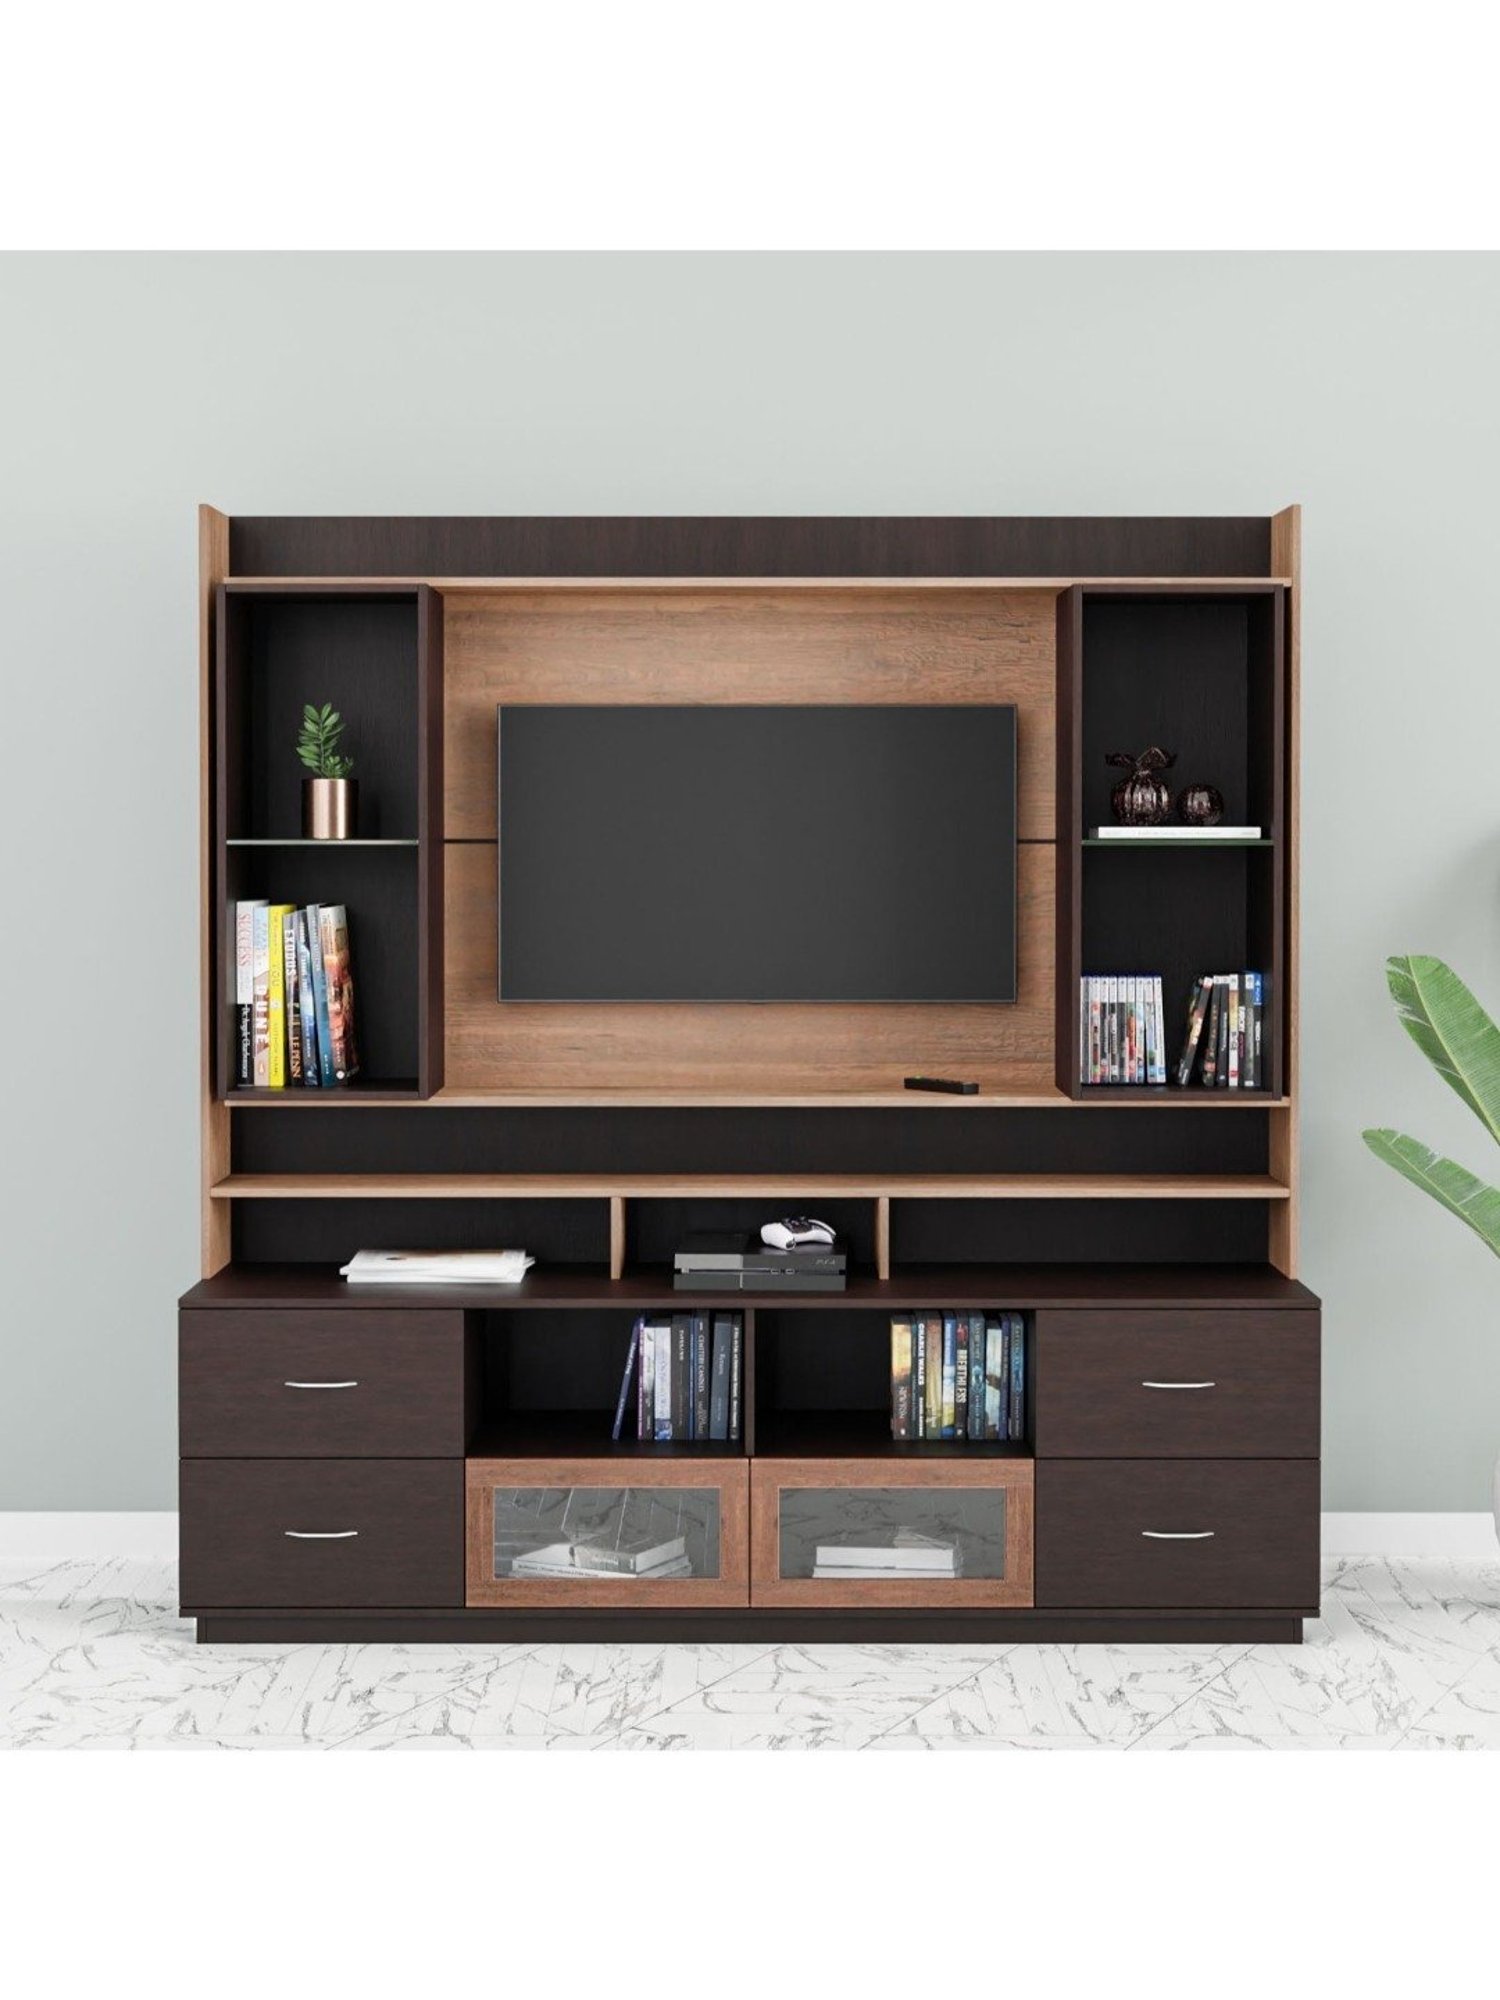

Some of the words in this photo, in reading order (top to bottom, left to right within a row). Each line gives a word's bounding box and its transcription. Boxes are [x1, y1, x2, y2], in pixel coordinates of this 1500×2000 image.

[284, 929, 297, 977] EXODUS
[255, 985, 269, 1046] DUNE
[917, 1322, 925, 1357] CHARLIE
[917, 1358, 925, 1386] WALKS
